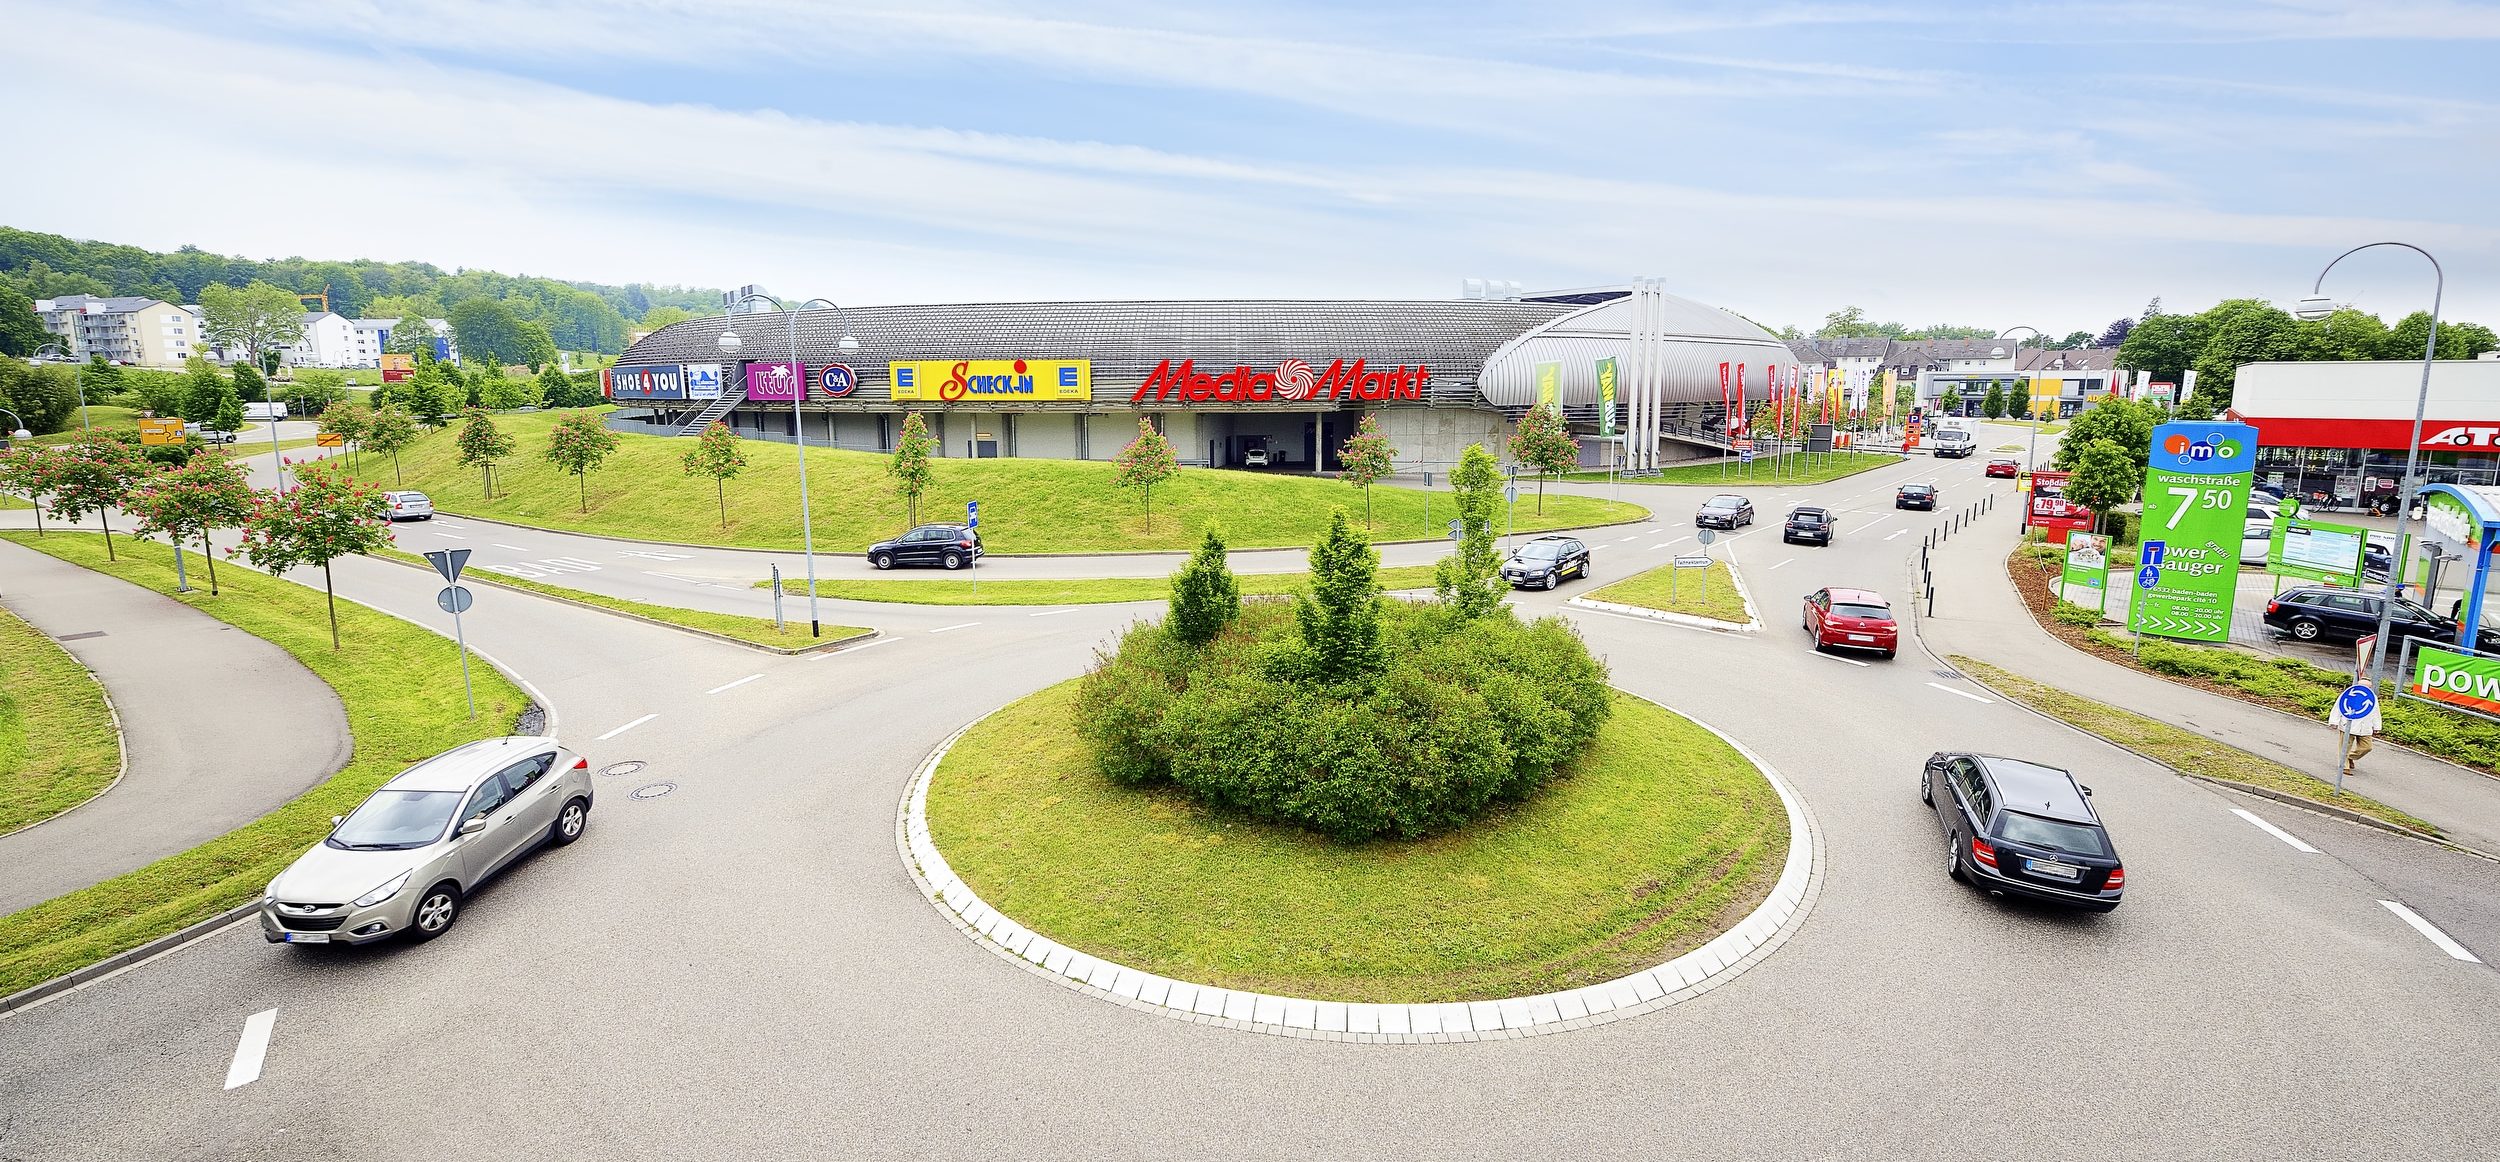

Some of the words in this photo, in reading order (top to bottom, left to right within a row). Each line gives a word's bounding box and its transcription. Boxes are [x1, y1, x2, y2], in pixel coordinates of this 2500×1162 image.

[616, 373, 640, 391] SHOE
[643, 373, 650, 391] 4
[652, 372, 678, 391] YOU
[825, 373, 848, 387] C&A
[1131, 358, 1275, 401] Media
[1303, 358, 1429, 400] Markt
[2179, 441, 2234, 459] imo
[2158, 475, 2240, 487] waschstraße
[2148, 502, 2157, 510] ab
[2202, 489, 2232, 510] 50
[2164, 546, 2209, 560] ower
[2172, 588, 2218, 598] baden-baden
